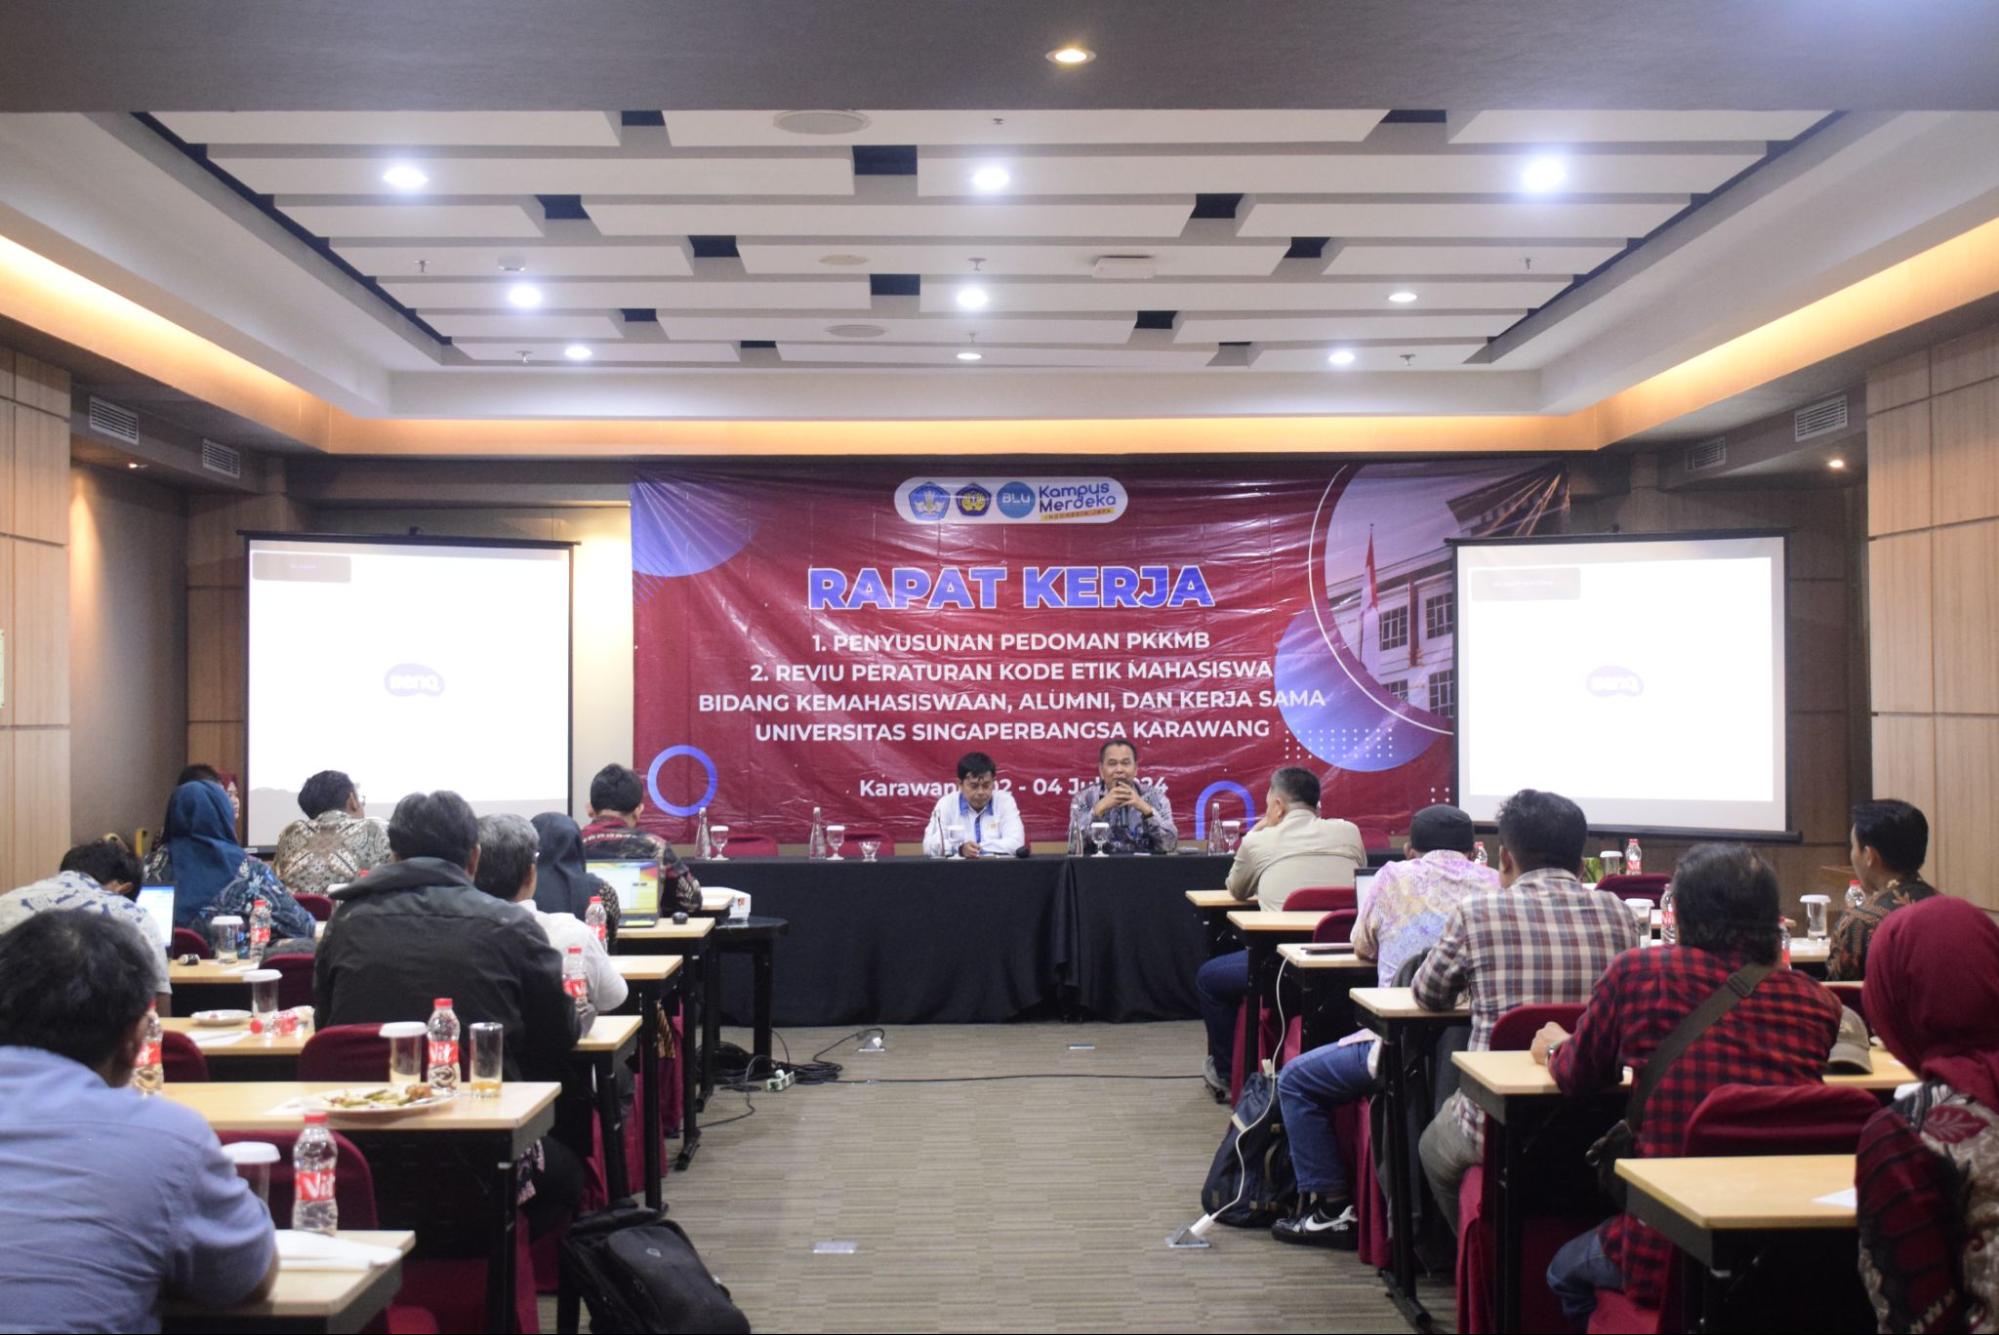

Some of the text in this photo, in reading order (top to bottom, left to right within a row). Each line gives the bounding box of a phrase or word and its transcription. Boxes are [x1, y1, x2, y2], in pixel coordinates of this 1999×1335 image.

[1039, 482, 1110, 498] Kampus
[1039, 494, 1117, 513] Merdeka
[807, 565, 1216, 610] RAPAT KERJA
[812, 631, 1210, 652] 1. PENYUSUNAN PEDOMAN PKKMB
[750, 660, 1273, 682] 2. REVIU PERATURAN KODE ETIK MAHASISWA
[699, 689, 1326, 713] BIDANG KEMAHASISWAAN, ALUMNI, DAN KERJA SAMA
[755, 719, 1270, 742] UNIVERSITAS SINGAPERBANGSA KARAWANG
[860, 779, 961, 797] Karawan
[1033, 778, 1063, 795] 04
